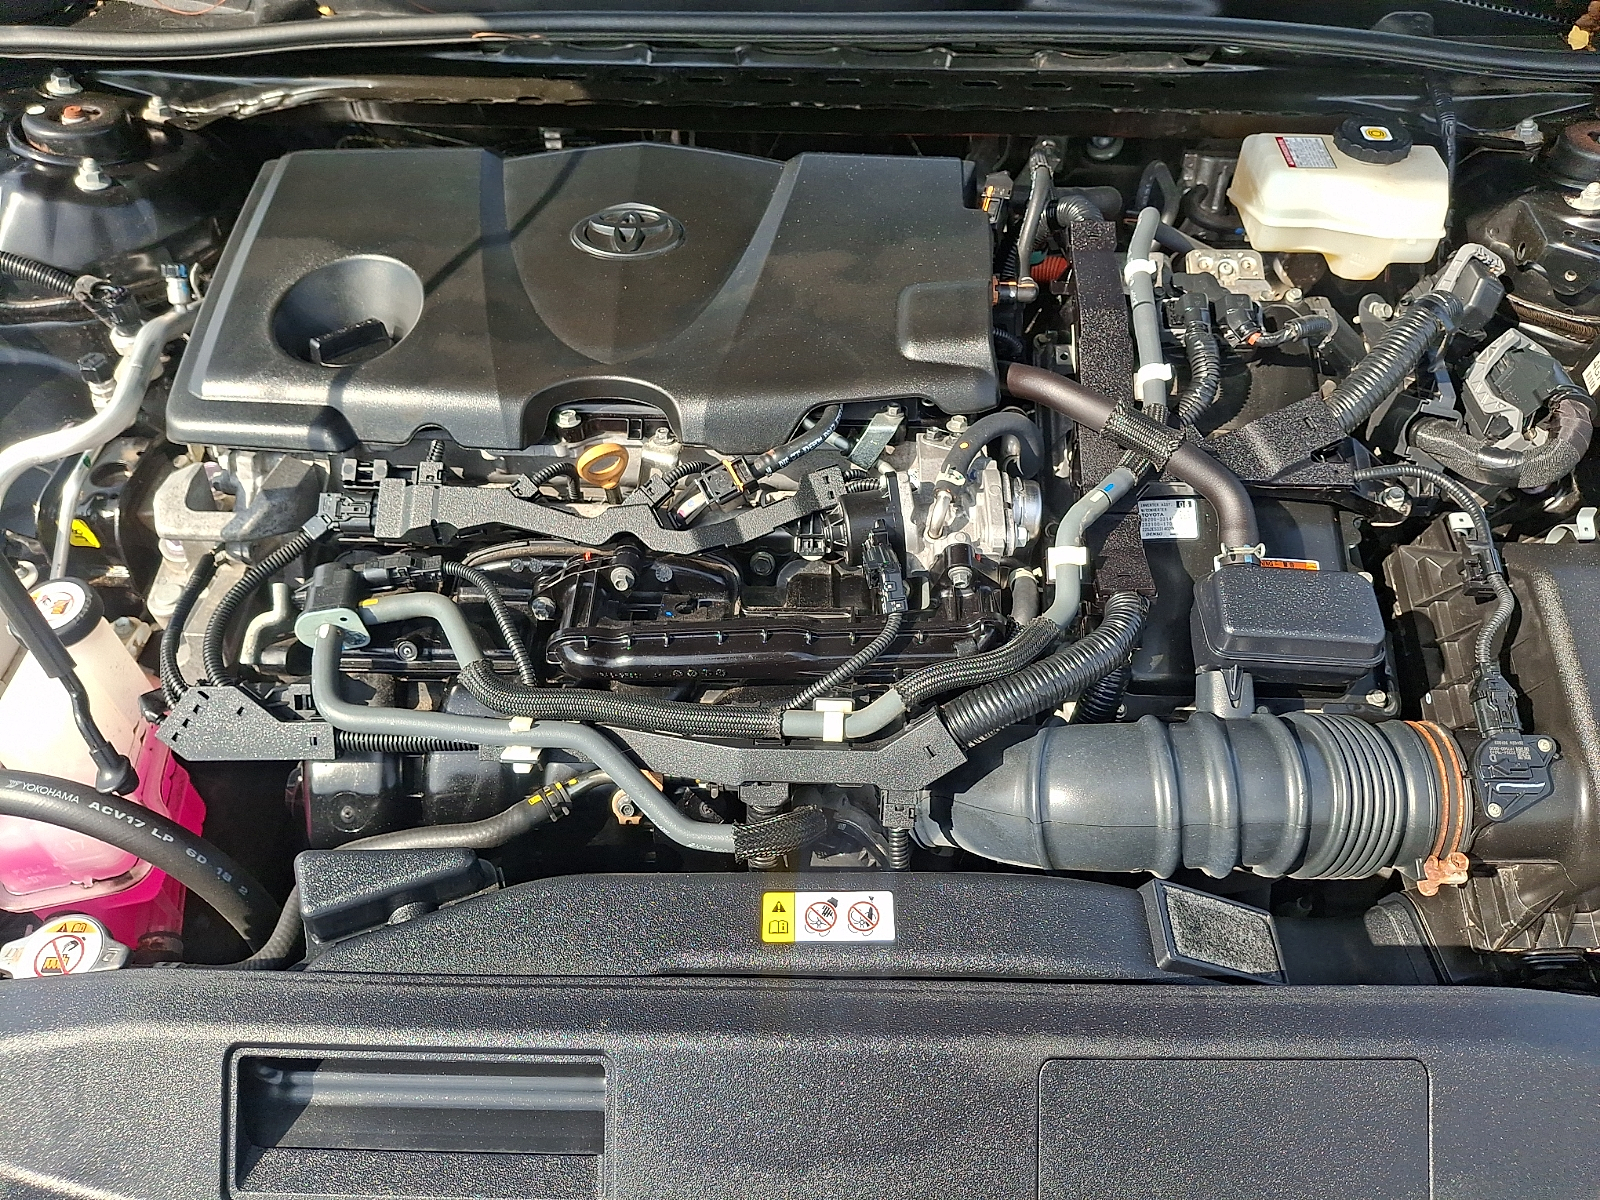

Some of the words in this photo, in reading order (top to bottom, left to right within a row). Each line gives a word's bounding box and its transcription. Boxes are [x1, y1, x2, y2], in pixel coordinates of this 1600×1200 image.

[22, 782, 79, 804] YOKOHAMA
[88, 801, 146, 828] ACV17
[151, 828, 174, 843] LP
